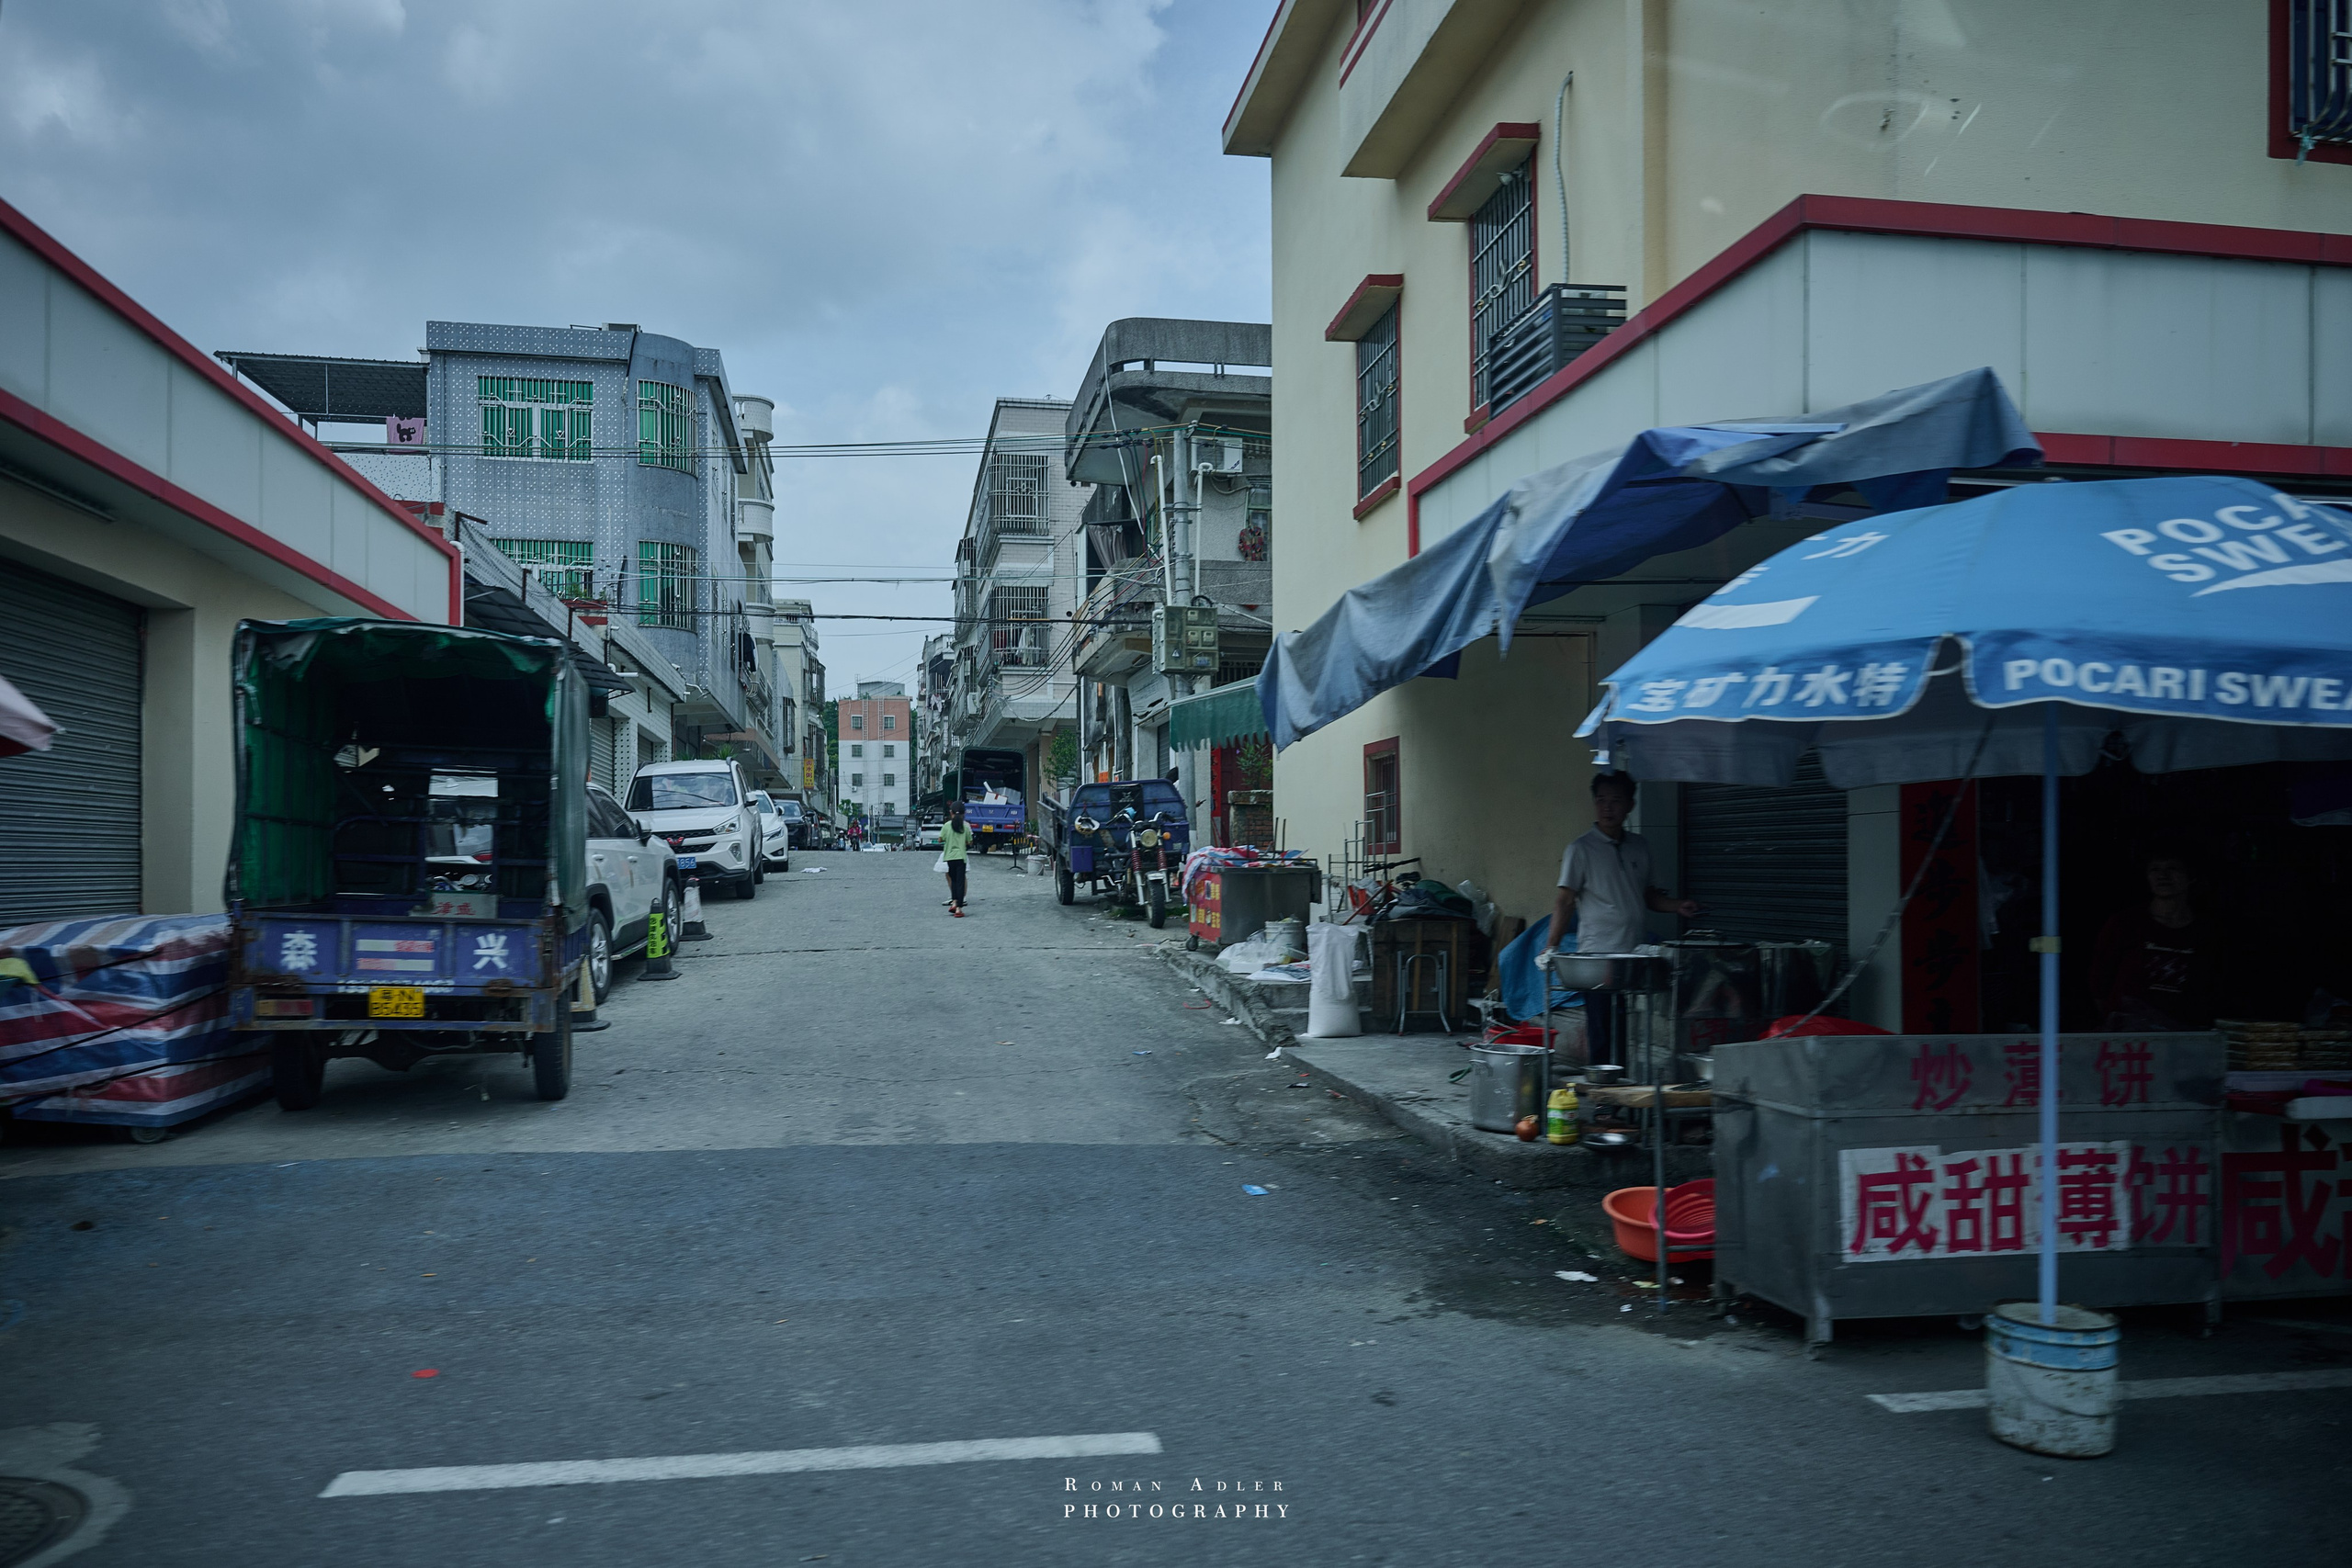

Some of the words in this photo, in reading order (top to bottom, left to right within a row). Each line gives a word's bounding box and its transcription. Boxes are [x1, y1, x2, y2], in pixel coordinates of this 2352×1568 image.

[1625, 660, 1911, 714] 宝矿力水特
[2005, 657, 2208, 702] POCARI
[280, 930, 318, 971] 森
[472, 932, 509, 971] 兴
[2220, 1122, 2352, 1281] 咸
